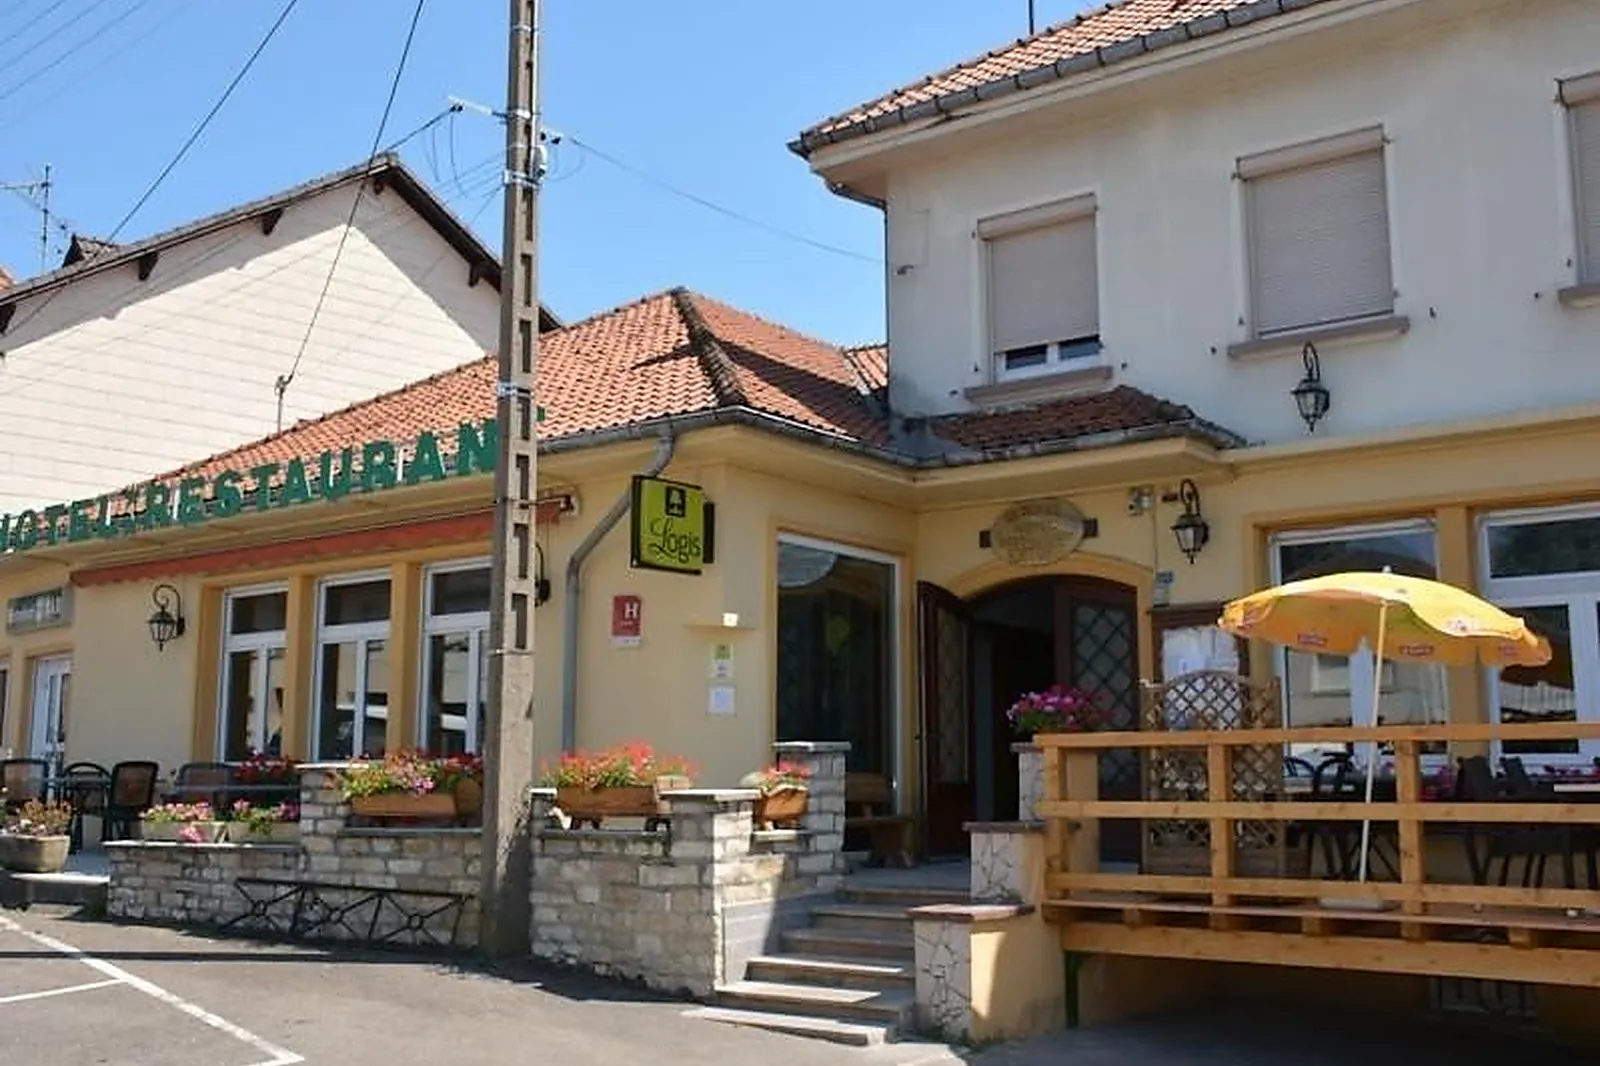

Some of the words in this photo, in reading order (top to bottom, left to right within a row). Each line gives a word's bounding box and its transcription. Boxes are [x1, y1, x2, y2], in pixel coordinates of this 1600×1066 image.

[147, 406, 545, 527] RESTAURAN
[648, 517, 701, 564] Logis
[624, 601, 639, 620] H
